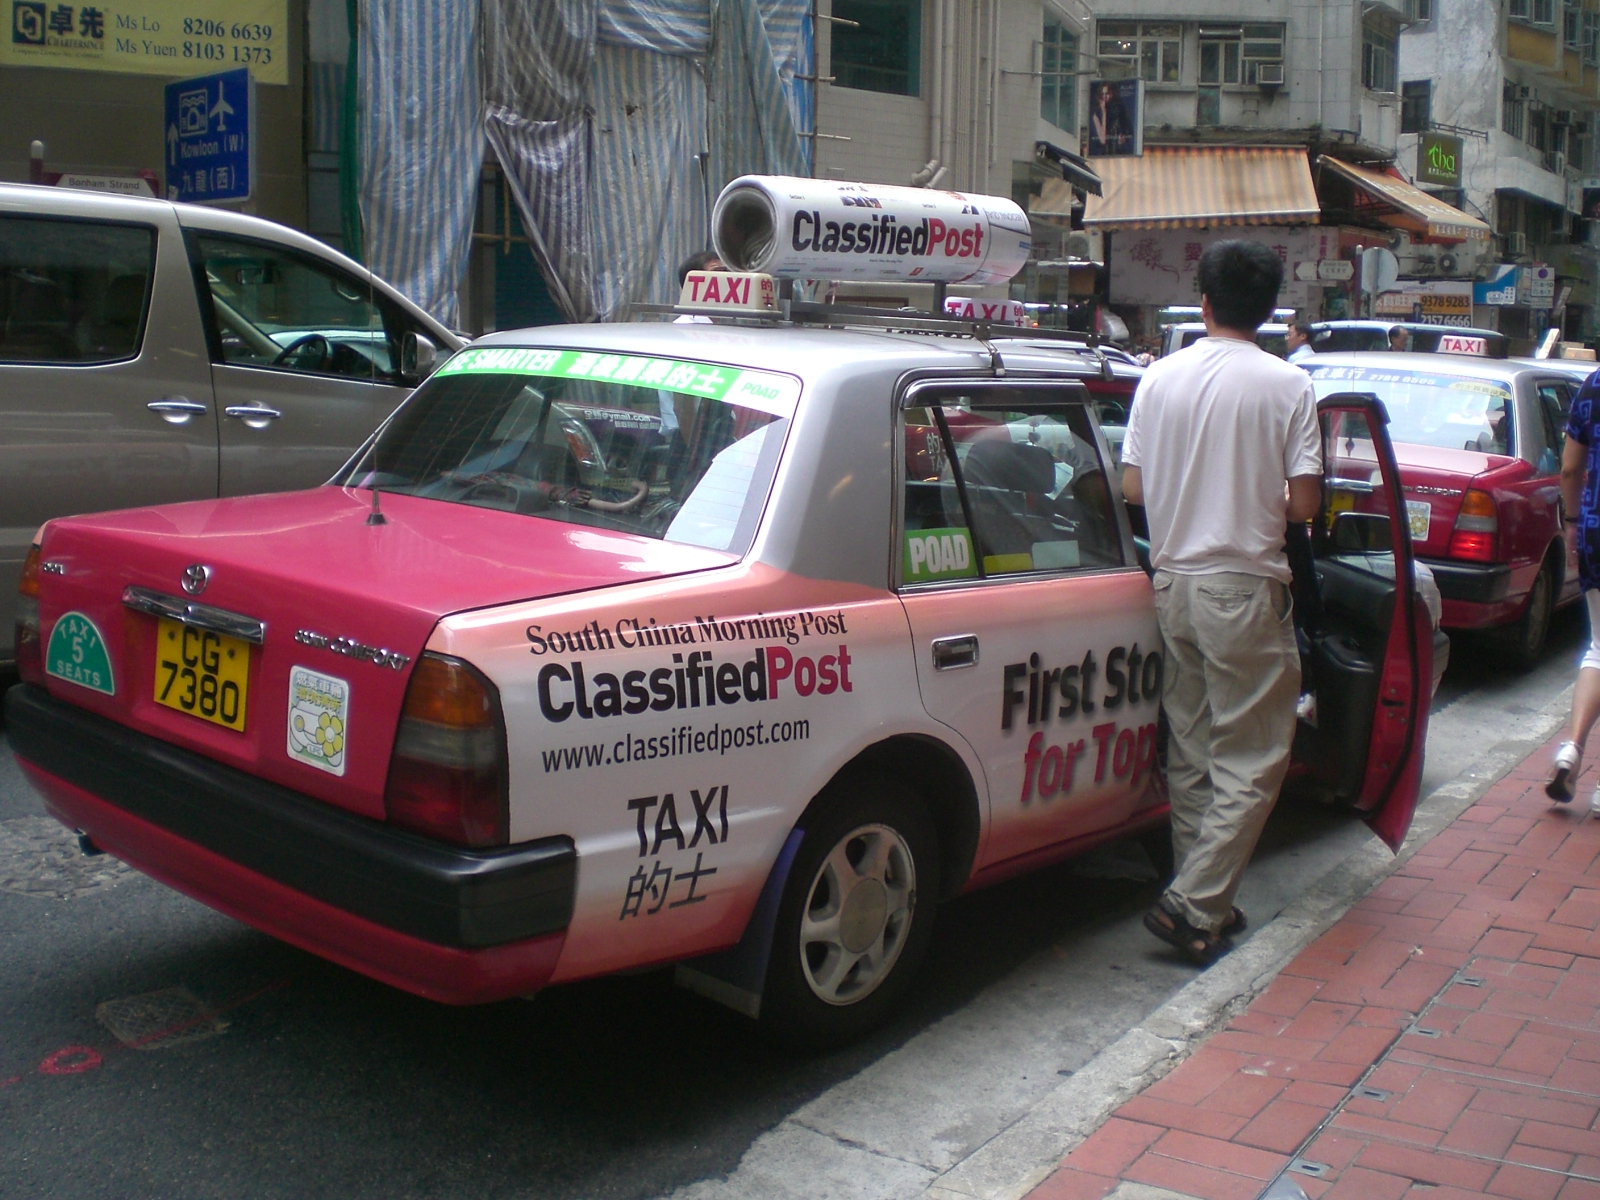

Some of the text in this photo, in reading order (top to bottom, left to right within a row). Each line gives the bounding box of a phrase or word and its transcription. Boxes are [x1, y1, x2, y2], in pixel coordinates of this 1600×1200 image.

[48, 4, 104, 38] 卓先
[116, 14, 272, 42] Ms Lo 8206 6639
[116, 38, 272, 65] Ms Yuen 8103 1373
[181, 132, 244, 158] Kowloon (W)
[68, 178, 140, 190] Bonham Strand
[688, 276, 751, 304] TAXI
[760, 278, 774, 305] 的士
[1421, 315, 1471, 327] 2157 6666
[1442, 338, 1484, 353] TAXI
[445, 349, 562, 372] BE SMARTER
[741, 382, 780, 400] POAD
[1369, 374, 1400, 383] 2788
[1402, 376, 1437, 386] 0505
[909, 534, 971, 575] POAD
[59, 619, 96, 648] TAXI
[526, 610, 848, 655] South China Morning Post
[72, 636, 84, 664] 5
[182, 625, 220, 675] CG
[330, 636, 411, 671] COMFORT
[57, 660, 101, 686] SEATS
[160, 660, 239, 724] 7380
[1002, 650, 1097, 730] First
[542, 719, 811, 773] www.classifiedpost.com
[1021, 722, 1158, 802] for Top
[627, 784, 729, 857] TAXI
[619, 852, 718, 920] 的士
